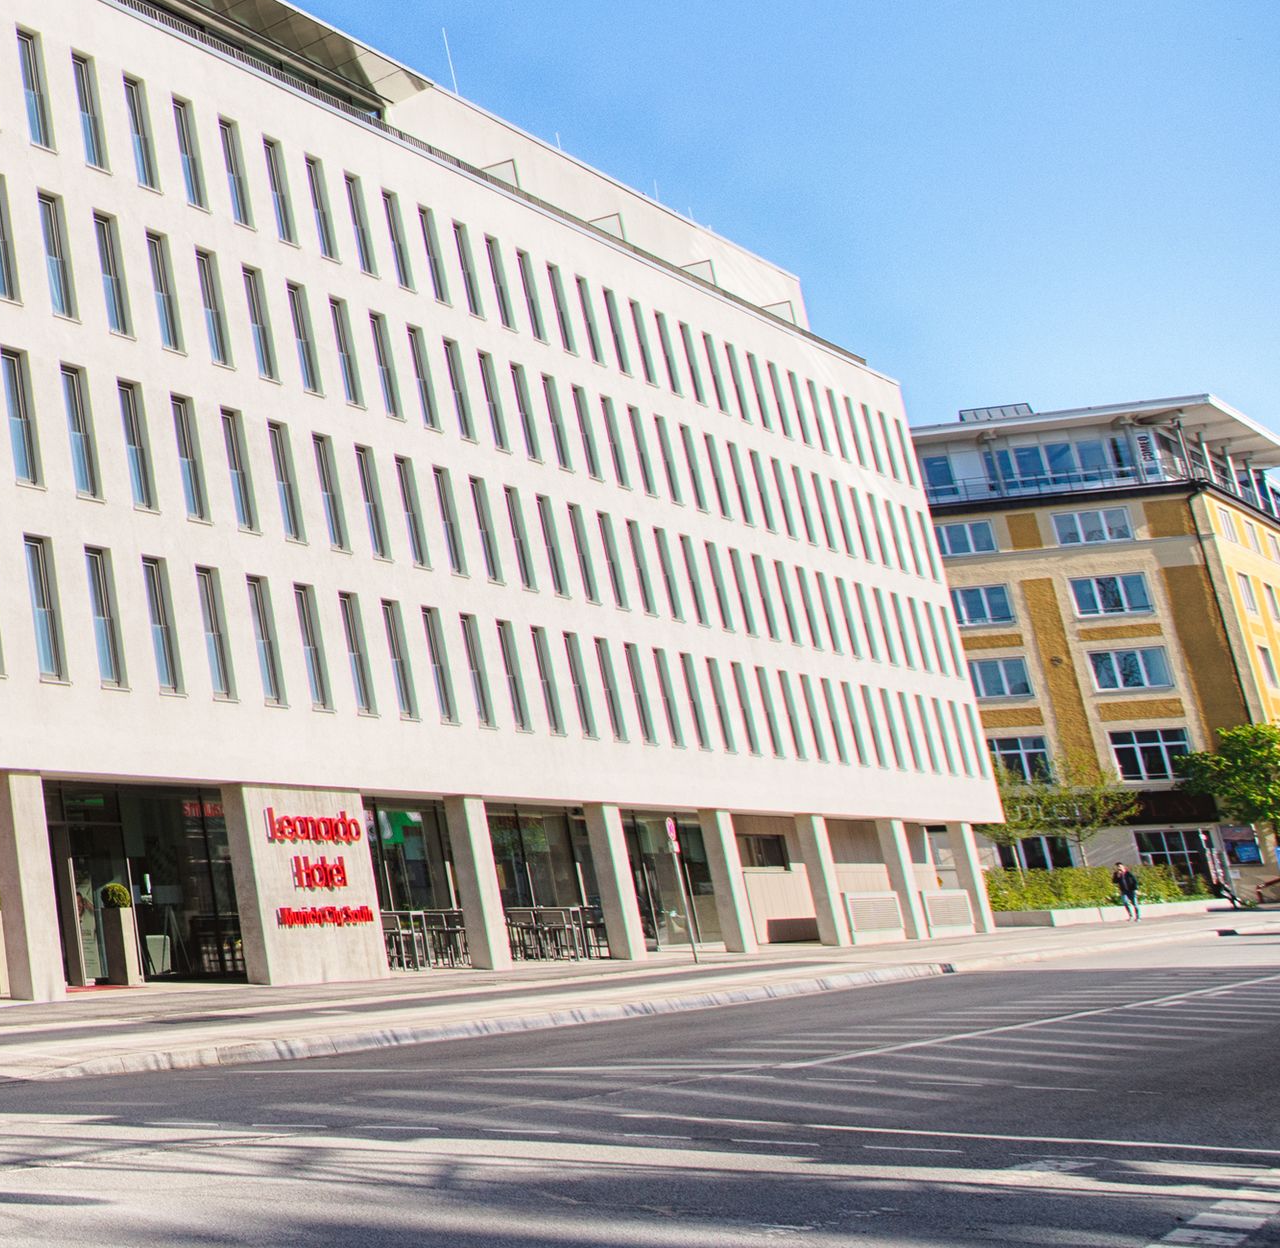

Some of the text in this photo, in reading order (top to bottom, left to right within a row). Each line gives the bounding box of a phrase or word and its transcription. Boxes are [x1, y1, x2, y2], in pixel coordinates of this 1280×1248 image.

[264, 807, 361, 843] Leonardo
[291, 856, 348, 888] Hotel
[278, 905, 374, 927] Munich City South
